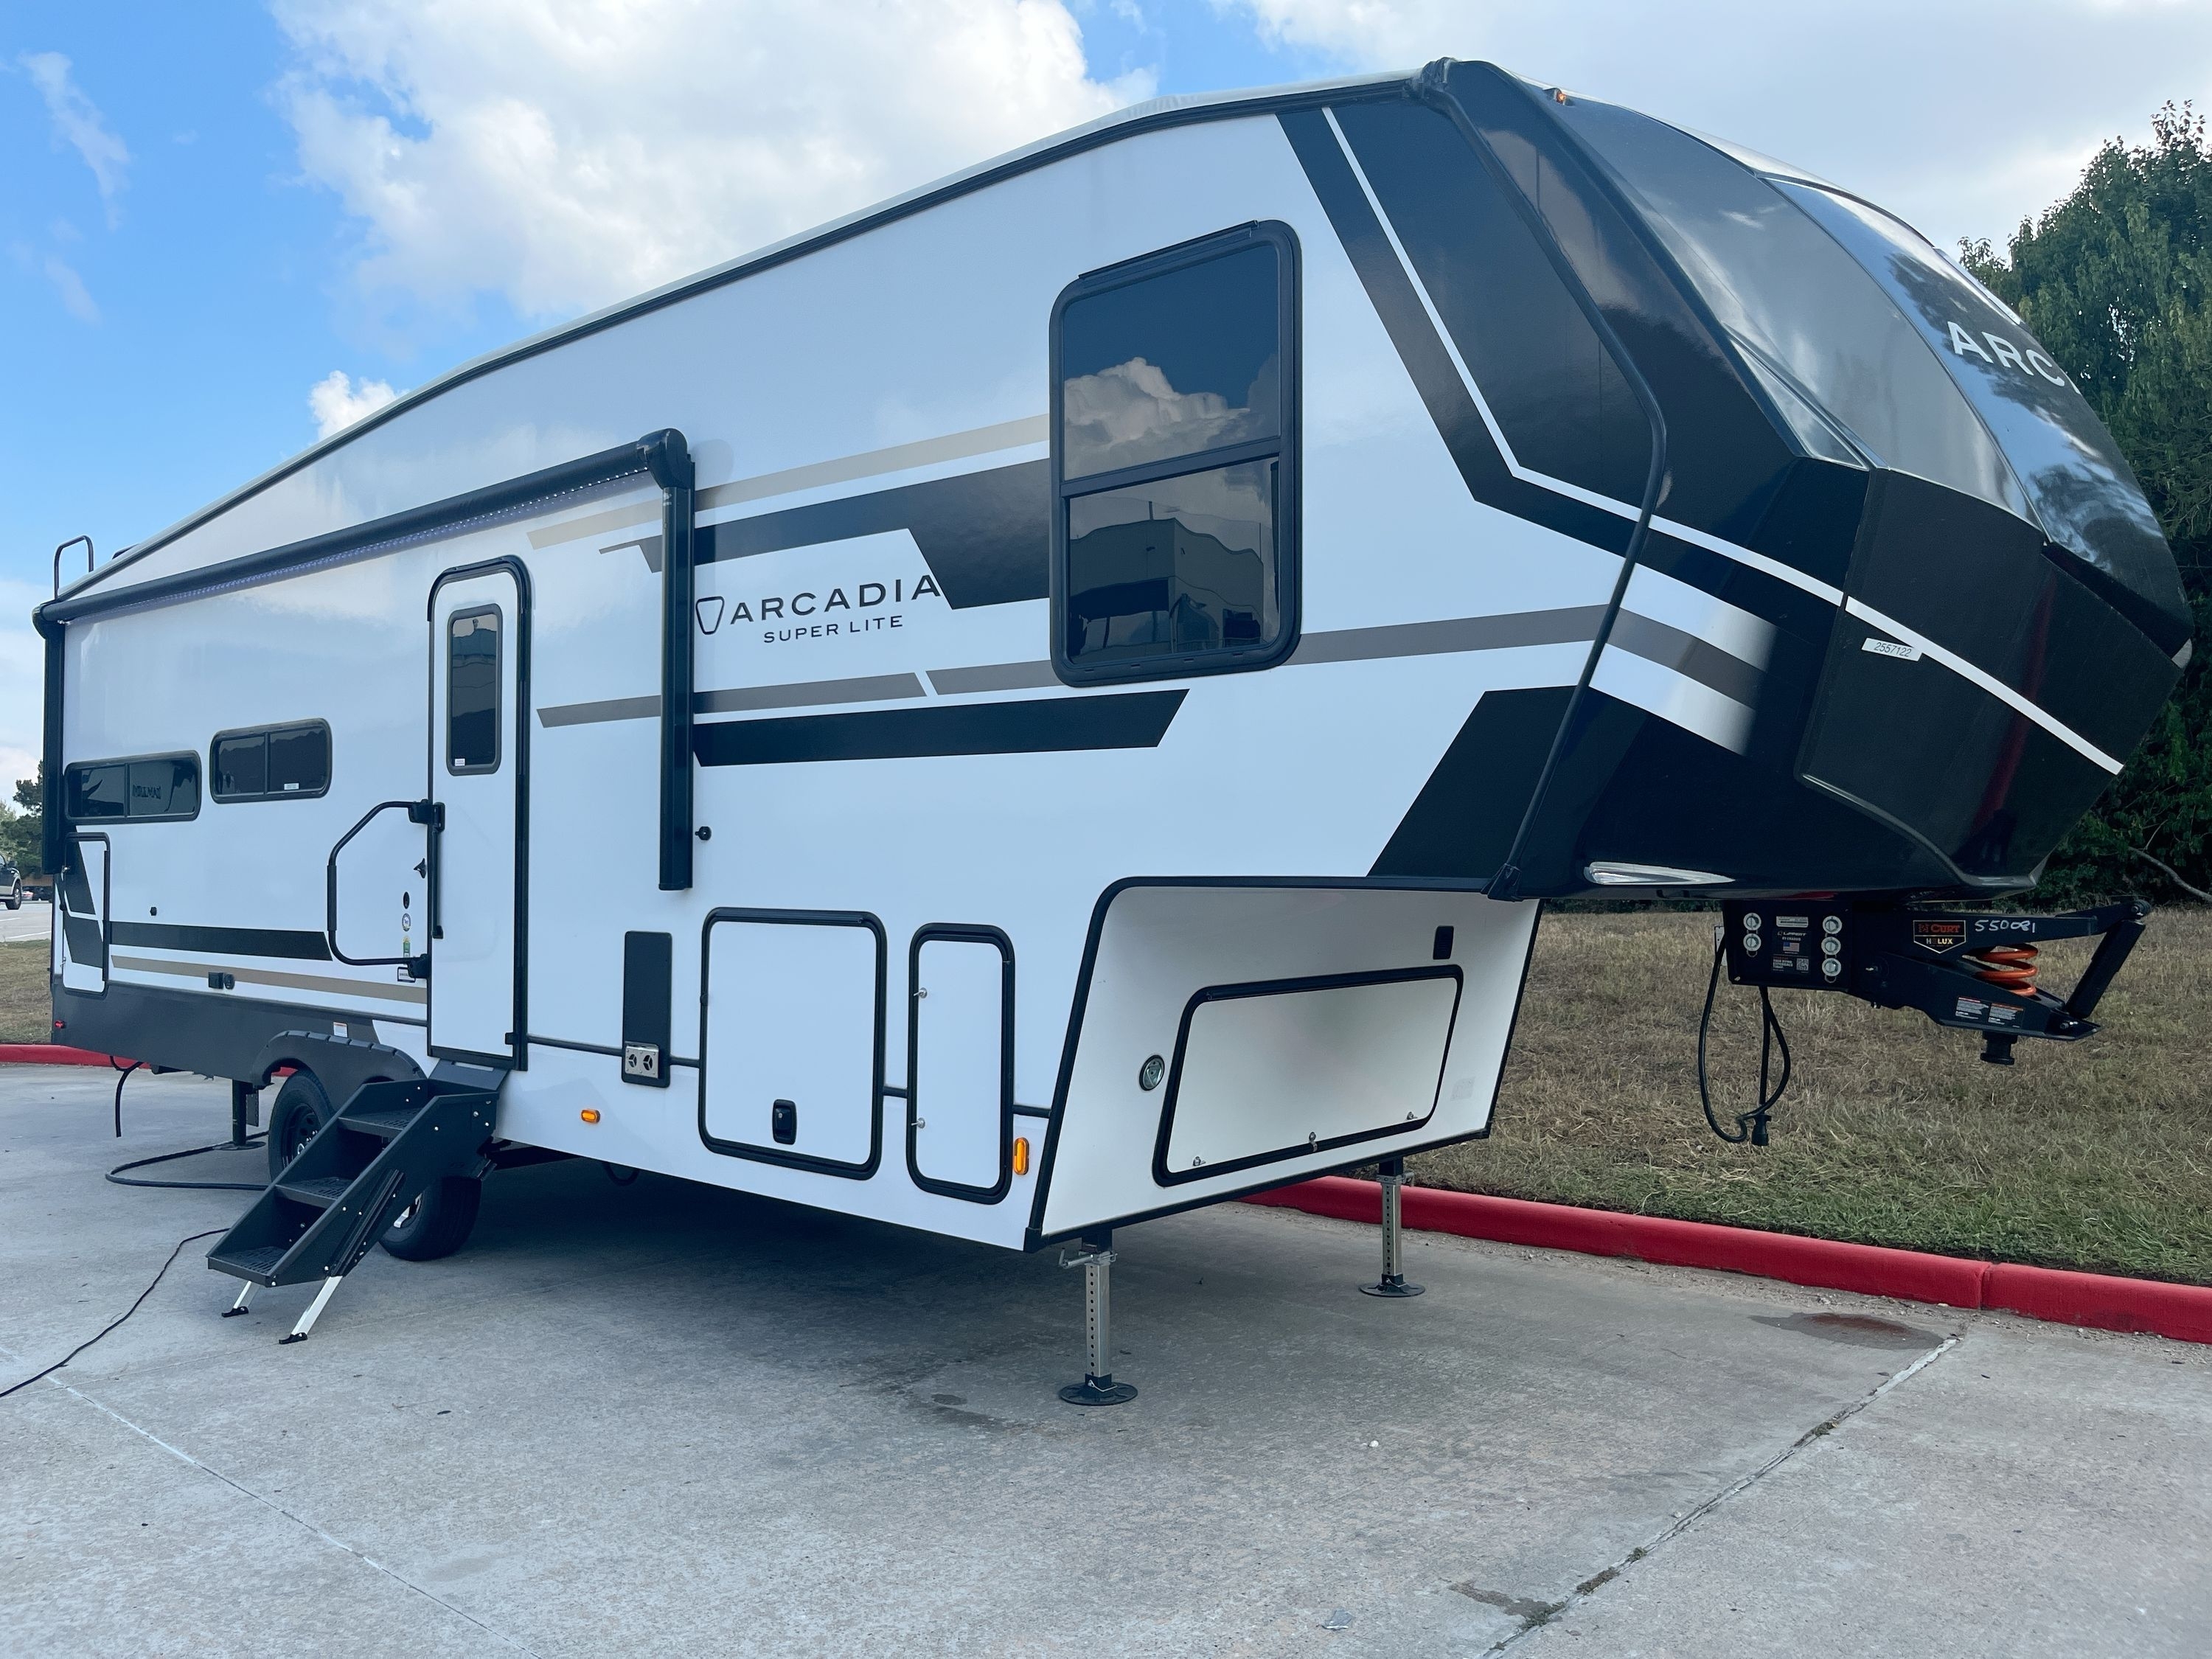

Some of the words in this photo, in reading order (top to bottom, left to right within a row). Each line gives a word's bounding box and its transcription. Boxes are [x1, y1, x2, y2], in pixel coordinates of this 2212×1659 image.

[1947, 321, 2081, 394] ARC
[730, 574, 941, 625] ARCADIA
[764, 623, 839, 643] SUPER
[849, 615, 903, 633] LITE
[1874, 641, 1912, 657] 2557122
